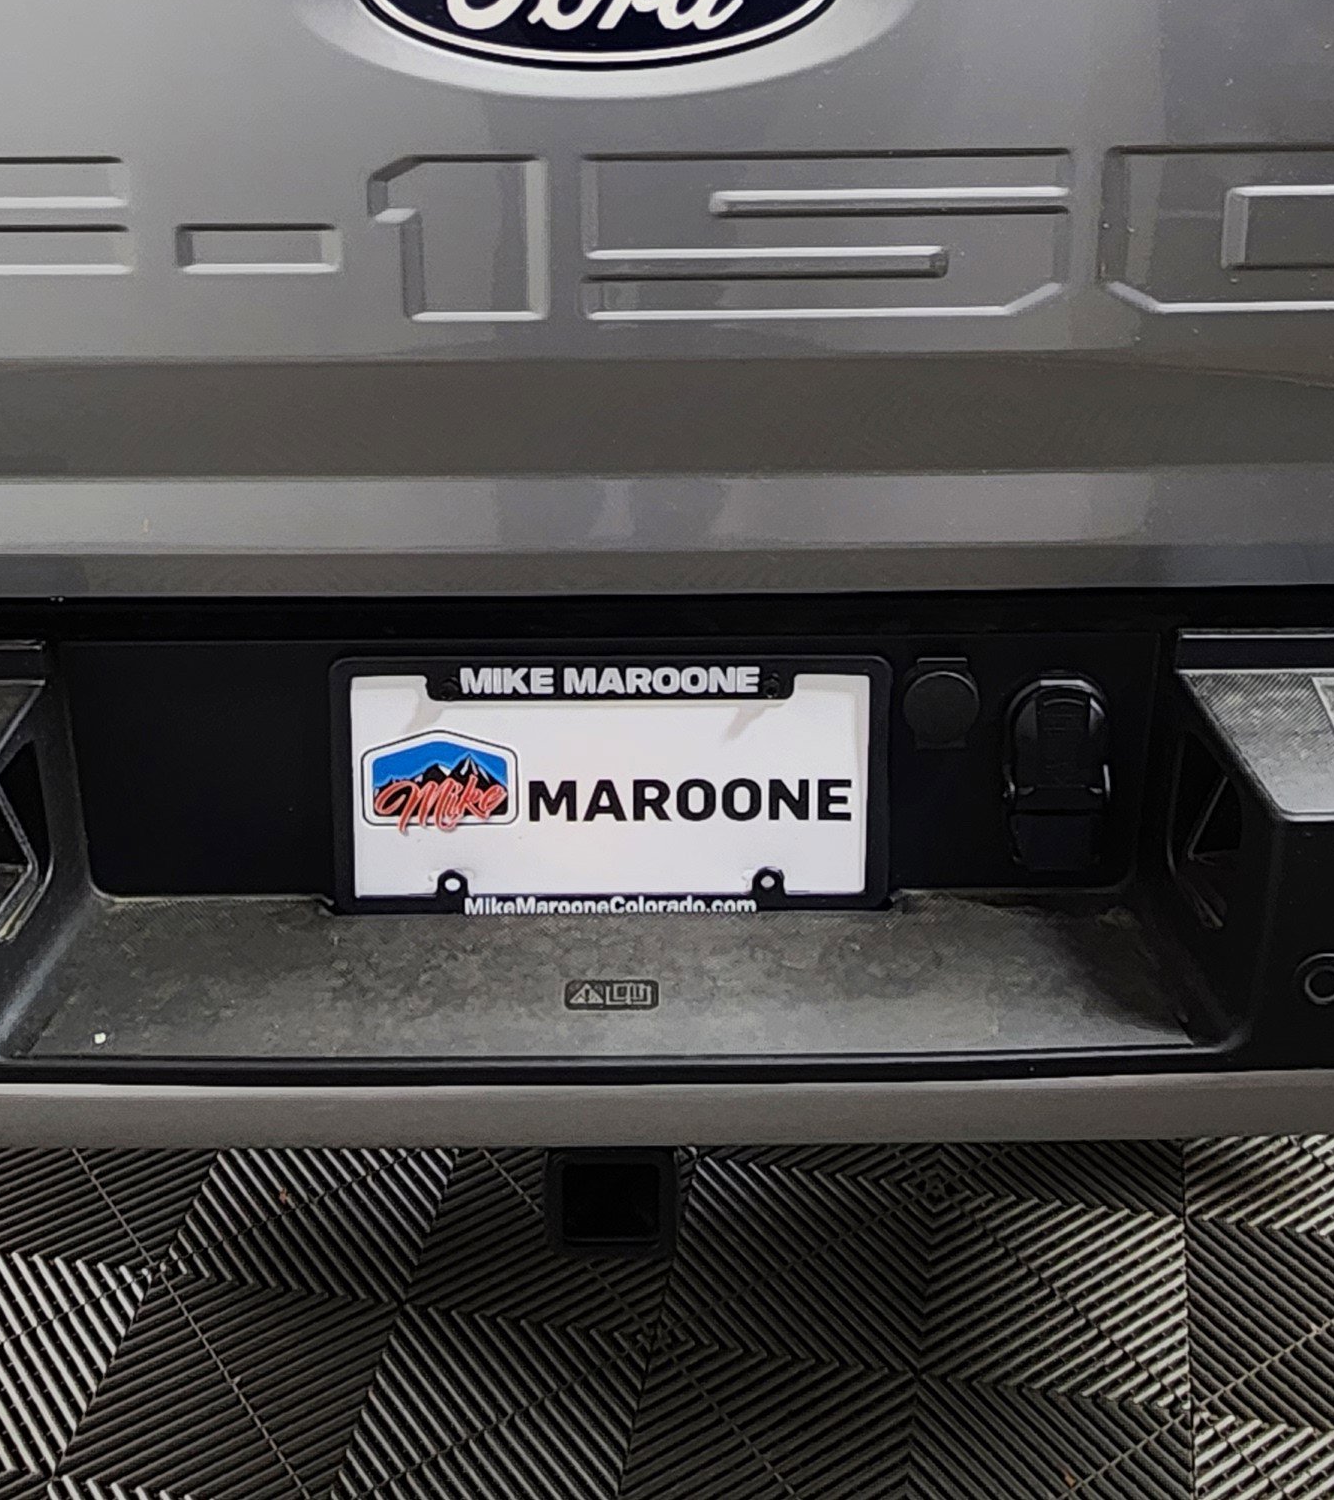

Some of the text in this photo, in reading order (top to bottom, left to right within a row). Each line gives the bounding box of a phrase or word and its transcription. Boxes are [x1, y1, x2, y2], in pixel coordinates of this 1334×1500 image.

[460, 666, 760, 695] MIKE MAROONE
[374, 773, 507, 834] Mike
[528, 779, 853, 822] MAROONE
[464, 895, 757, 915] MikeMarooneColorado.com
